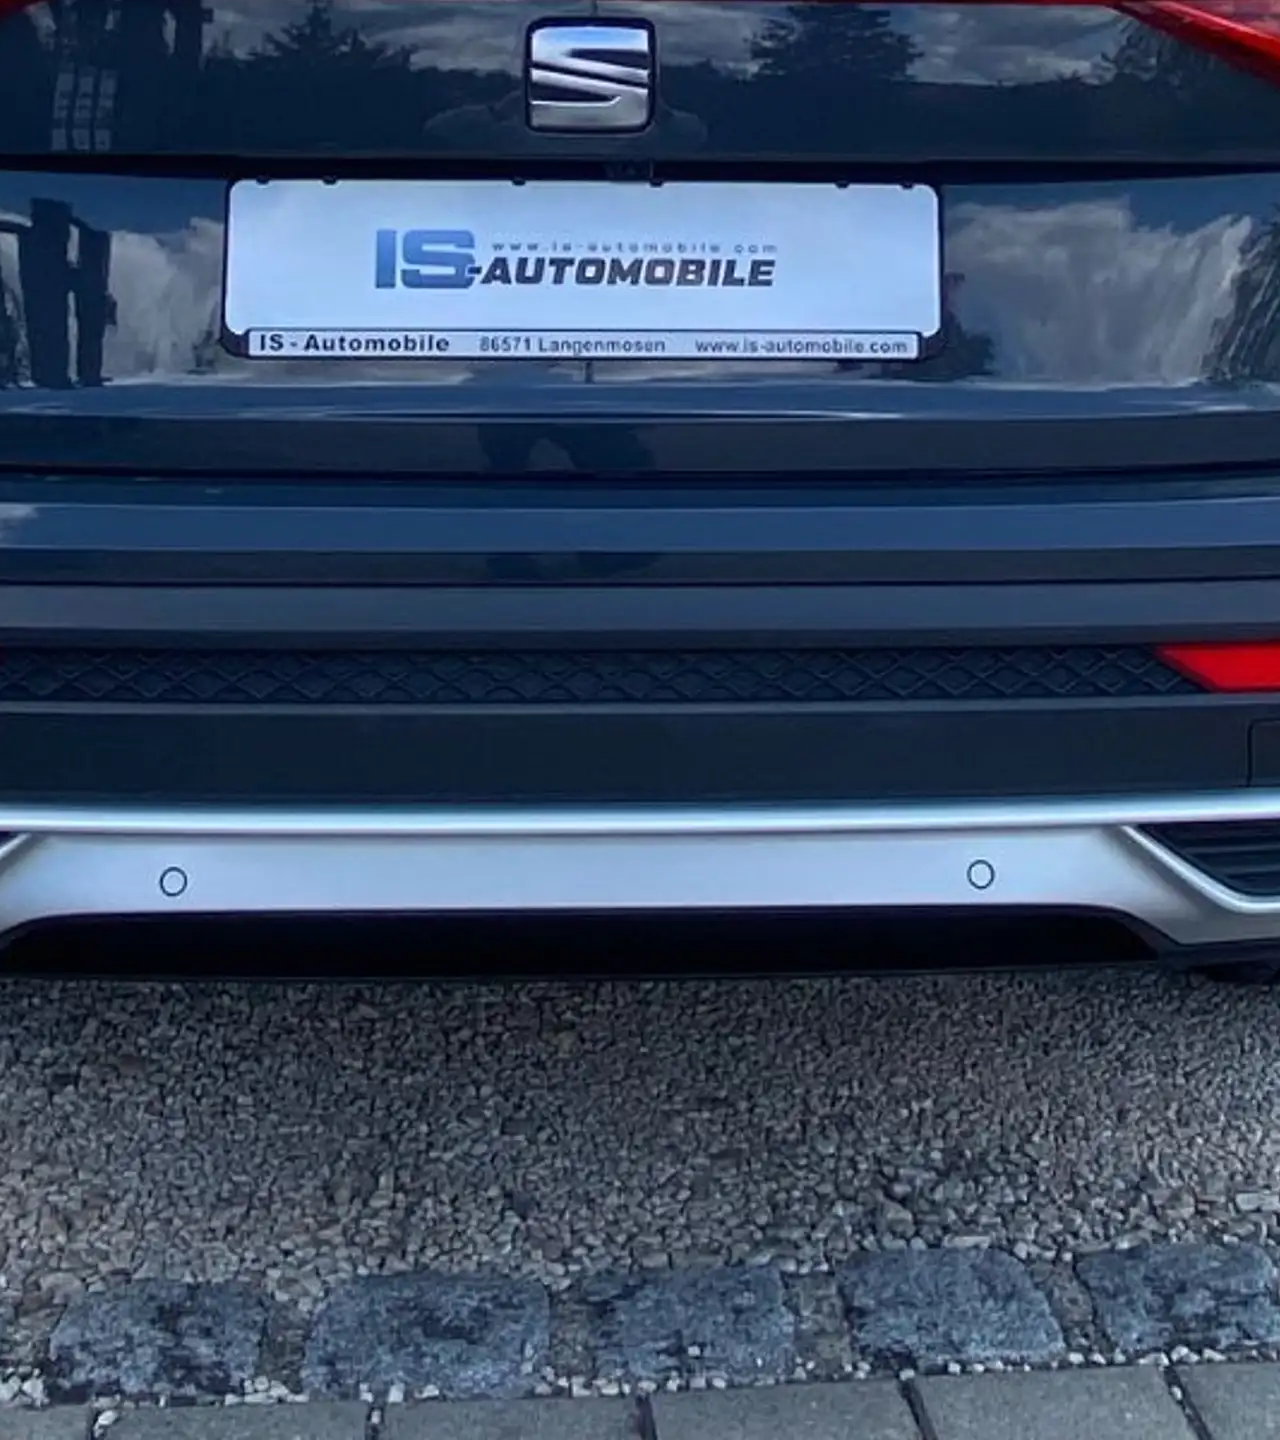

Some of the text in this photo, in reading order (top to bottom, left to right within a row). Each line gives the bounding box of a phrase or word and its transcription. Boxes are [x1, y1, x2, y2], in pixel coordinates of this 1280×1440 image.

[304, 334, 450, 351] Automobile
[479, 336, 531, 352] 86571
[695, 337, 907, 353] www.is-automobile.com
